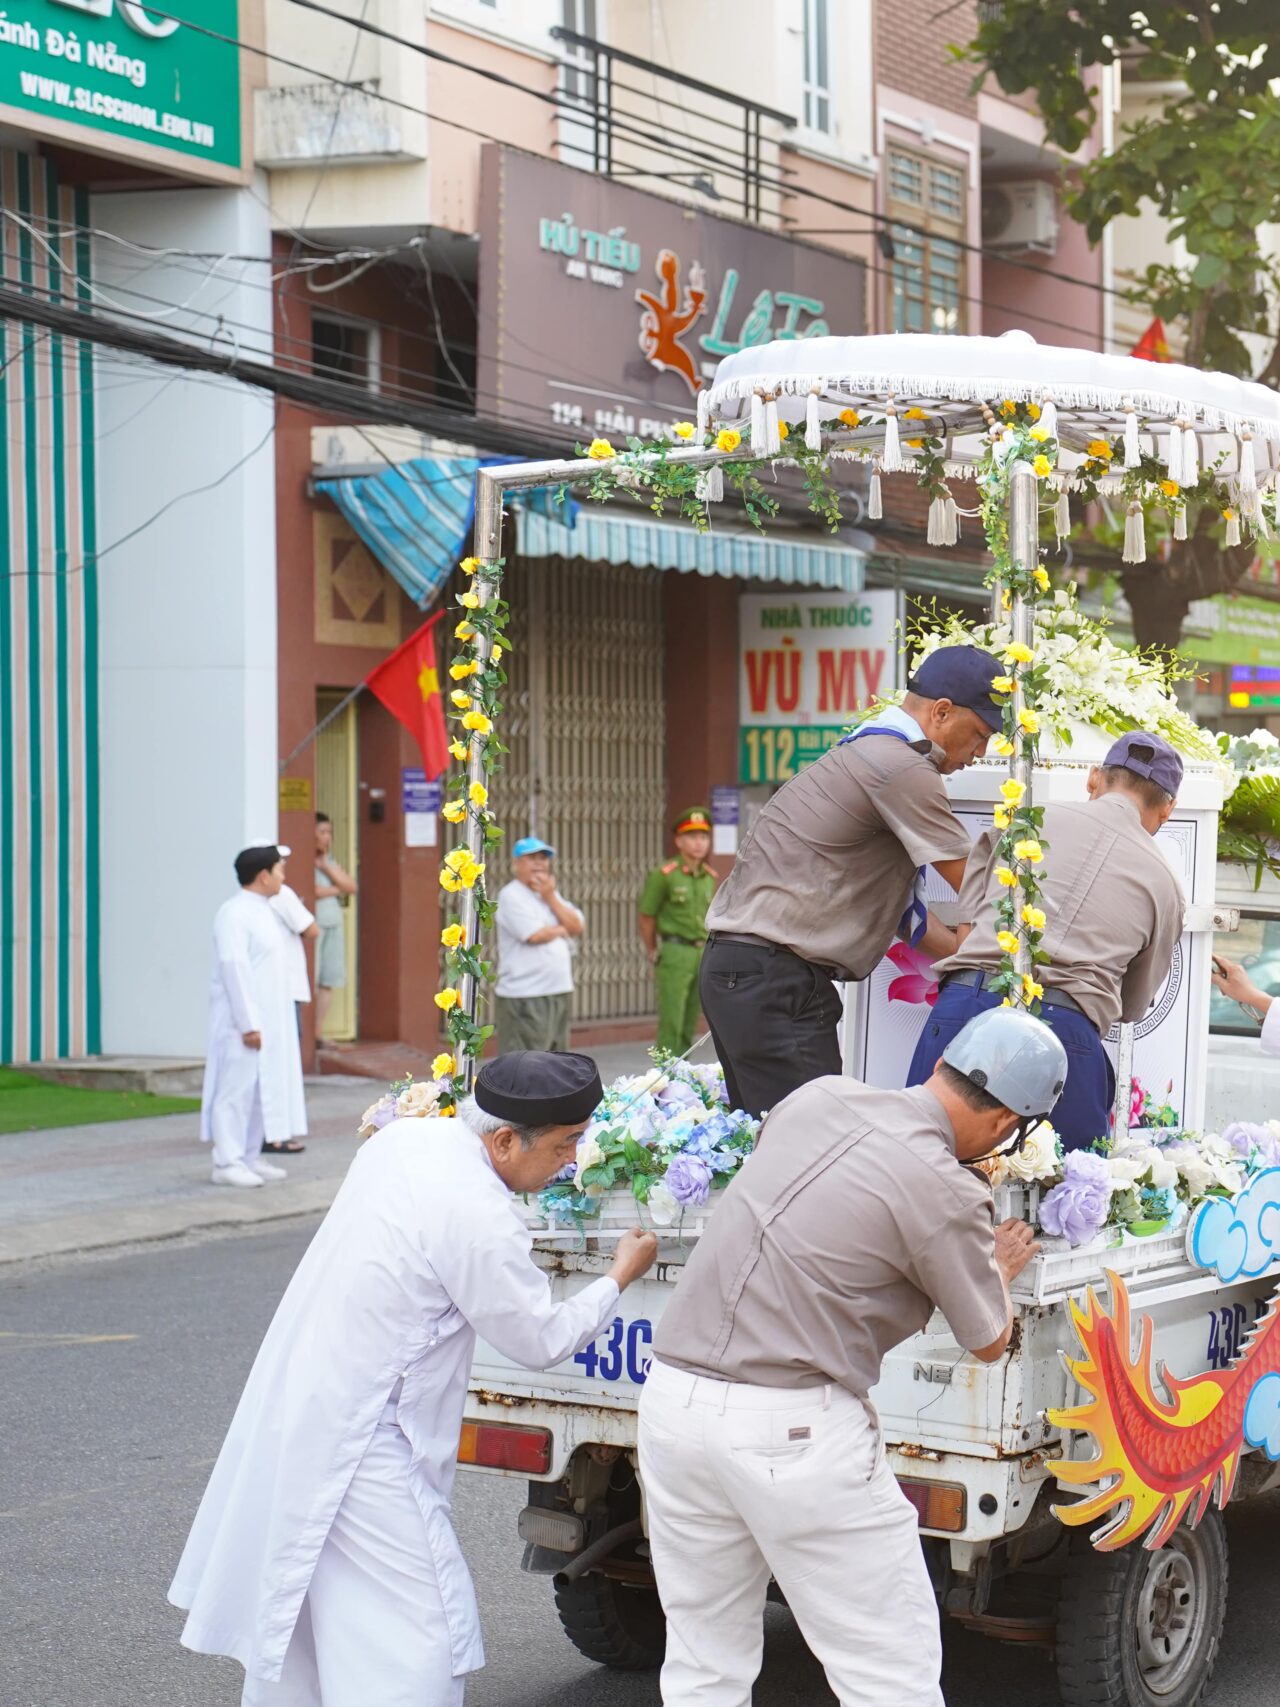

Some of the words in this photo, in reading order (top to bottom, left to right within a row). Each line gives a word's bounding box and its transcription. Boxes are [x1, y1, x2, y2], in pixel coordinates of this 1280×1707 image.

[45, 28, 81, 63] Đà
[87, 41, 146, 88] Nẵng
[20, 71, 215, 148] WWW.SLCSCHOOL.EDU.VN
[539, 212, 579, 256] HỦ
[580, 226, 640, 273] TIẾU
[761, 602, 802, 628] NHÀ
[808, 600, 872, 628] THUỐC
[746, 728, 795, 781] 112
[574, 1316, 652, 1385] 43C
